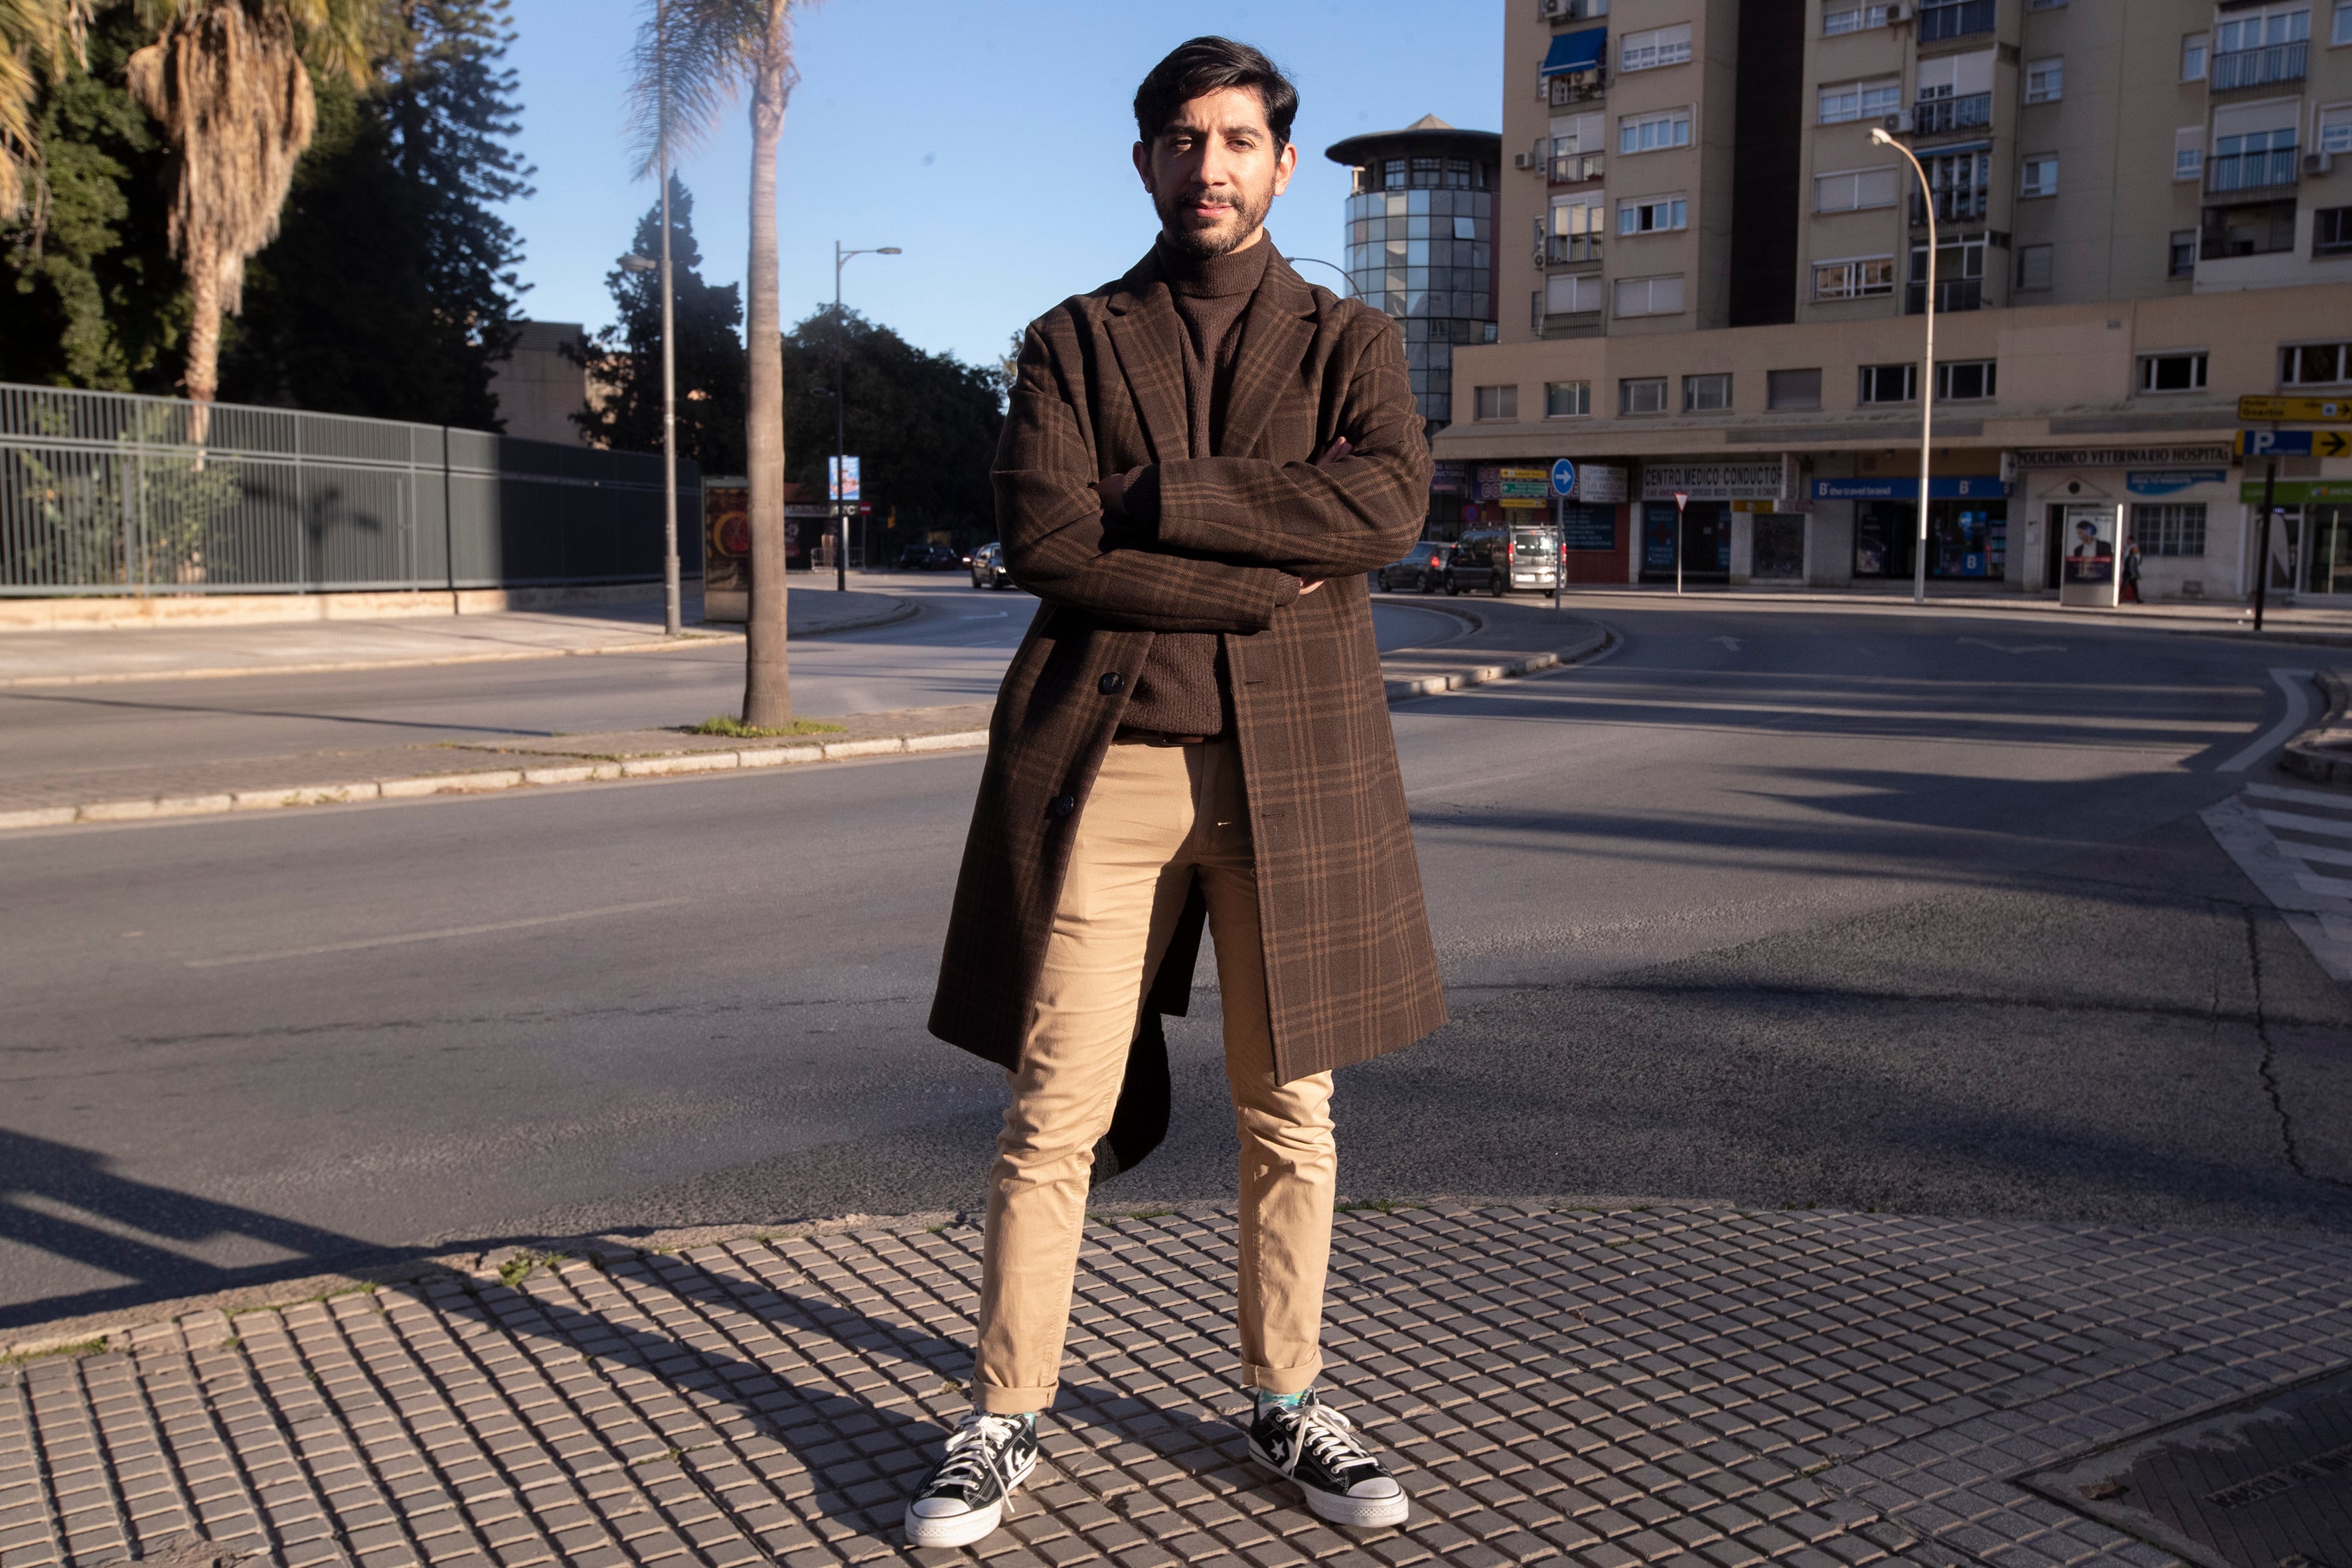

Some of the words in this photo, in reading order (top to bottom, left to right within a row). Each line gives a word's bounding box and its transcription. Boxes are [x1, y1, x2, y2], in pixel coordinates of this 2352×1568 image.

[2252, 431, 2275, 455] P
[1645, 468, 1680, 486] CENTRO
[1684, 467, 1719, 486] MEDICO
[1819, 482, 1828, 497] B
[1830, 487, 1843, 496] the
[1843, 487, 1866, 496] travel
[1867, 486, 1891, 496] brand
[1959, 480, 1969, 495] B
[1966, 554, 1976, 570] B
